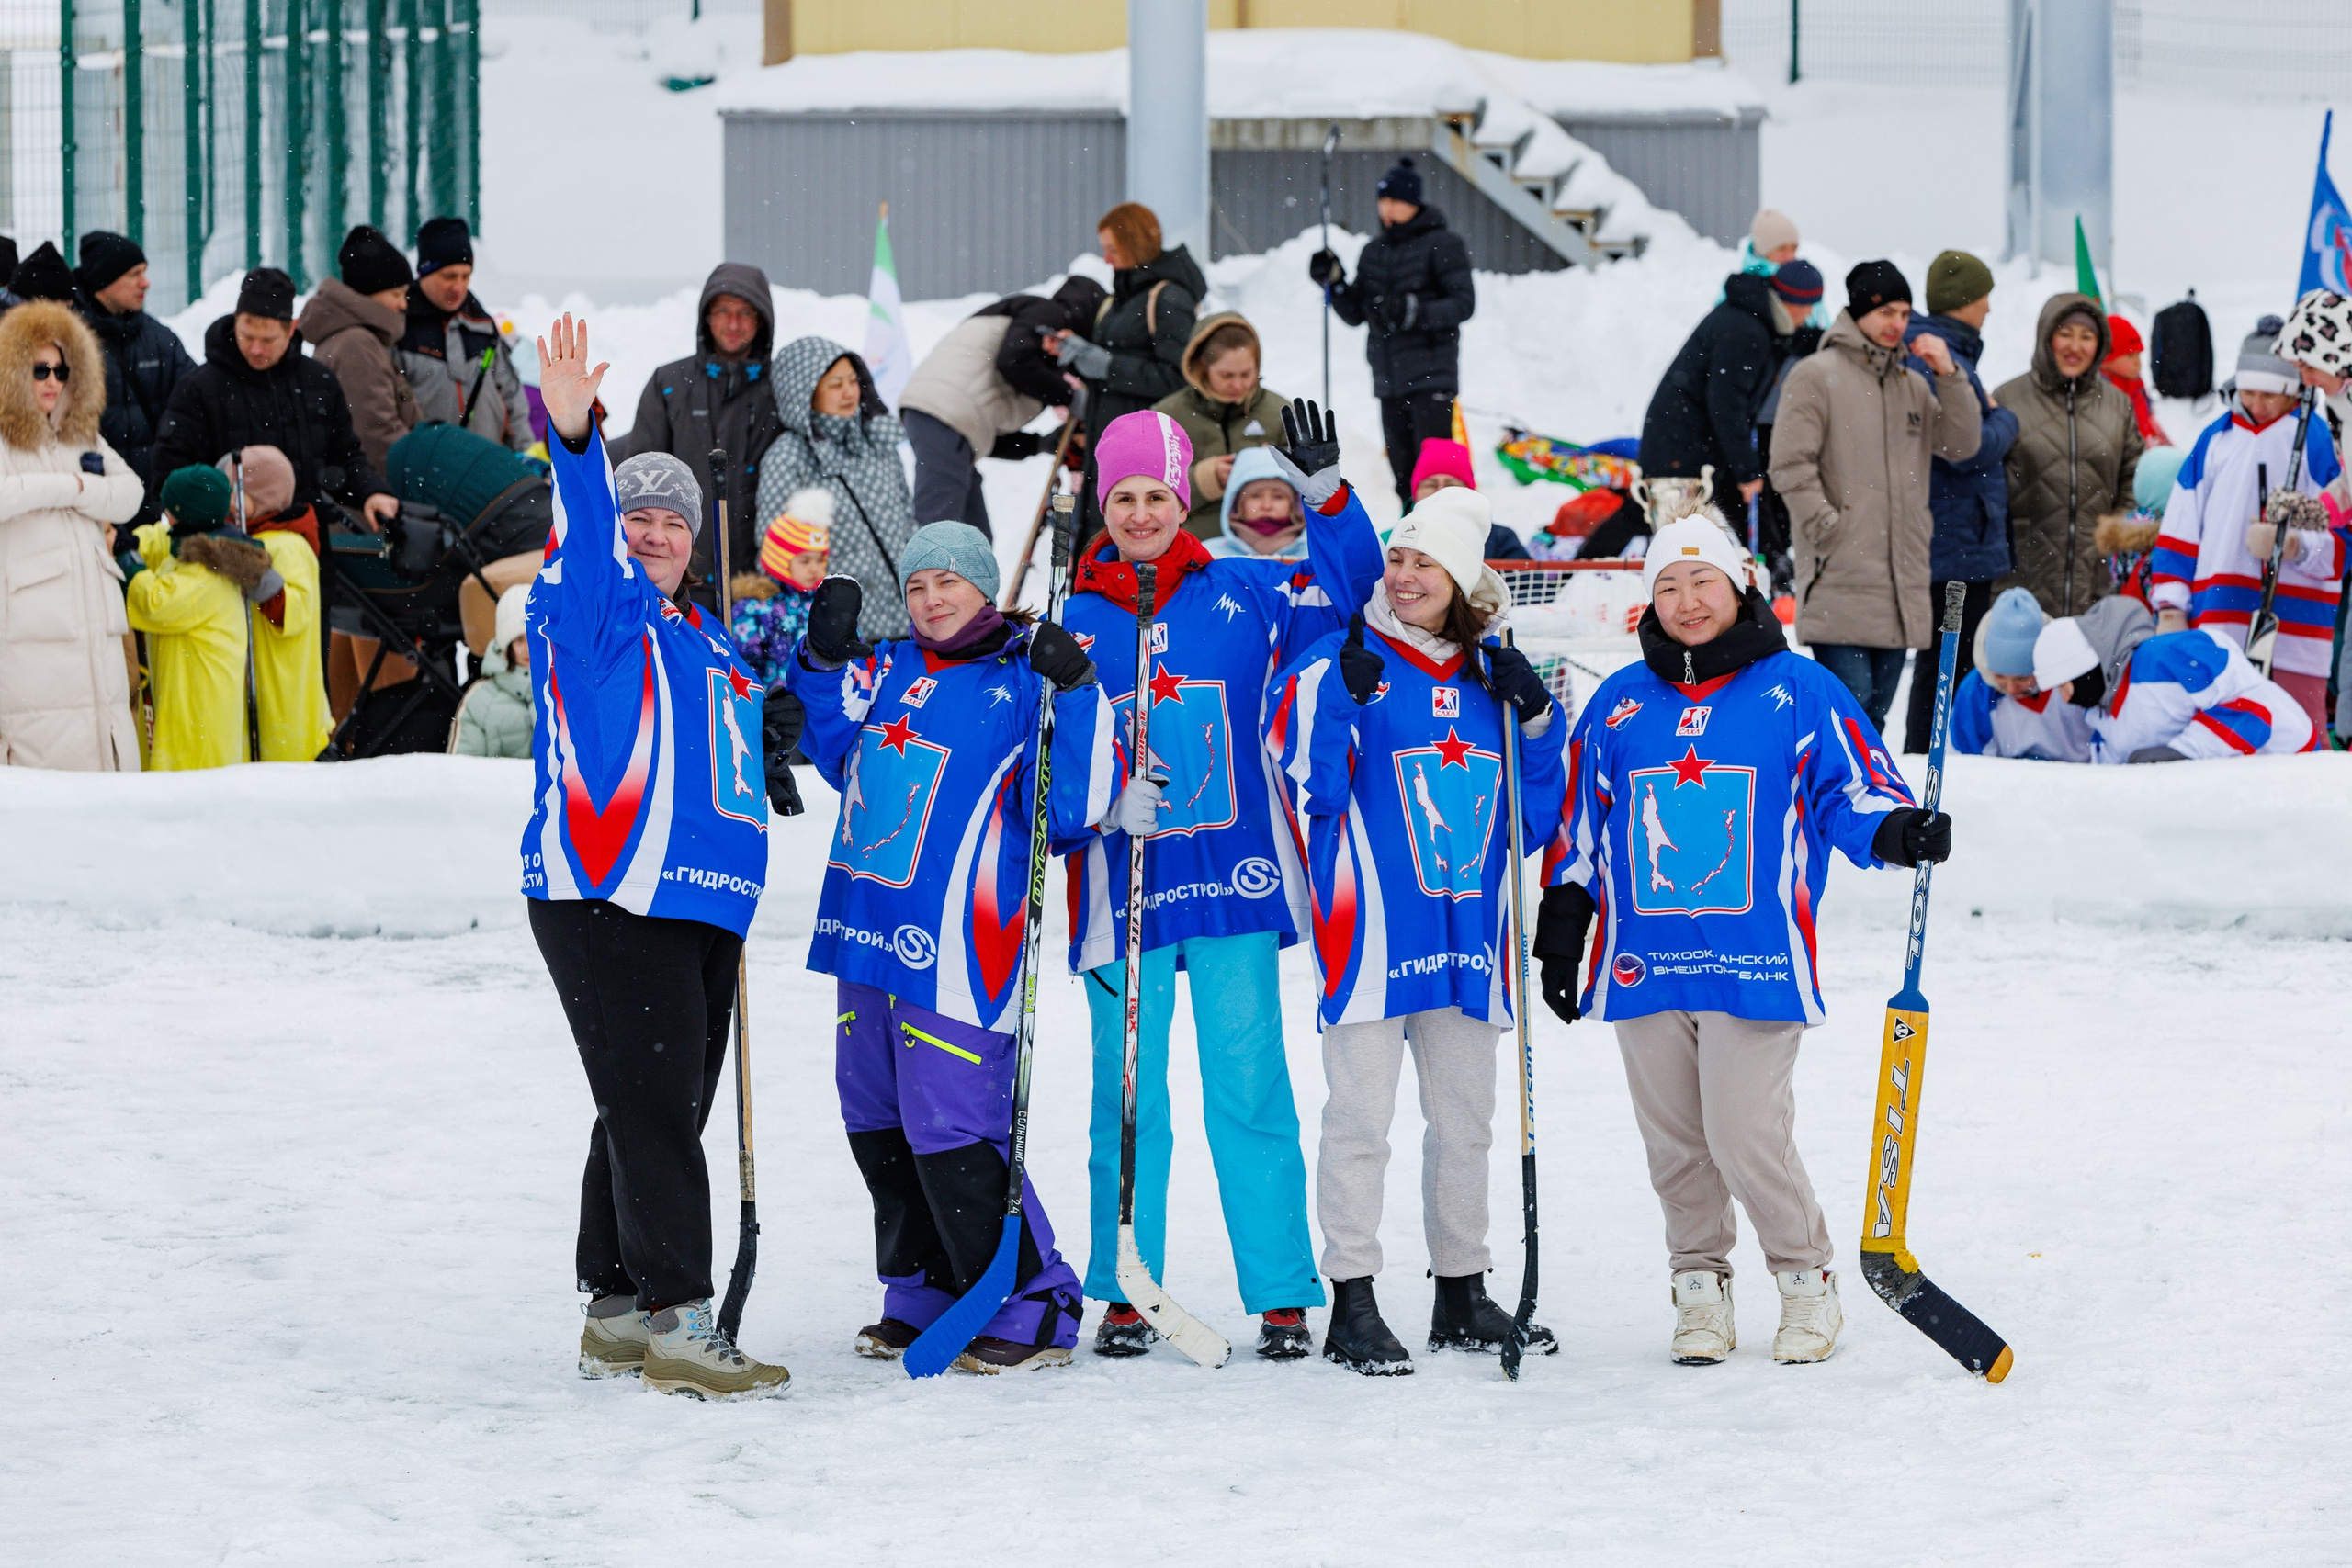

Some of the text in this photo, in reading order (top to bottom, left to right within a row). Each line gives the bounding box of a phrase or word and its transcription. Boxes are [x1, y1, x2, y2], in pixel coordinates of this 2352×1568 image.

[1933, 685, 1948, 749] TISA
[1647, 949, 1789, 966] ТИХООКАНСКИЙ
[1872, 1057, 1911, 1238] TISA
